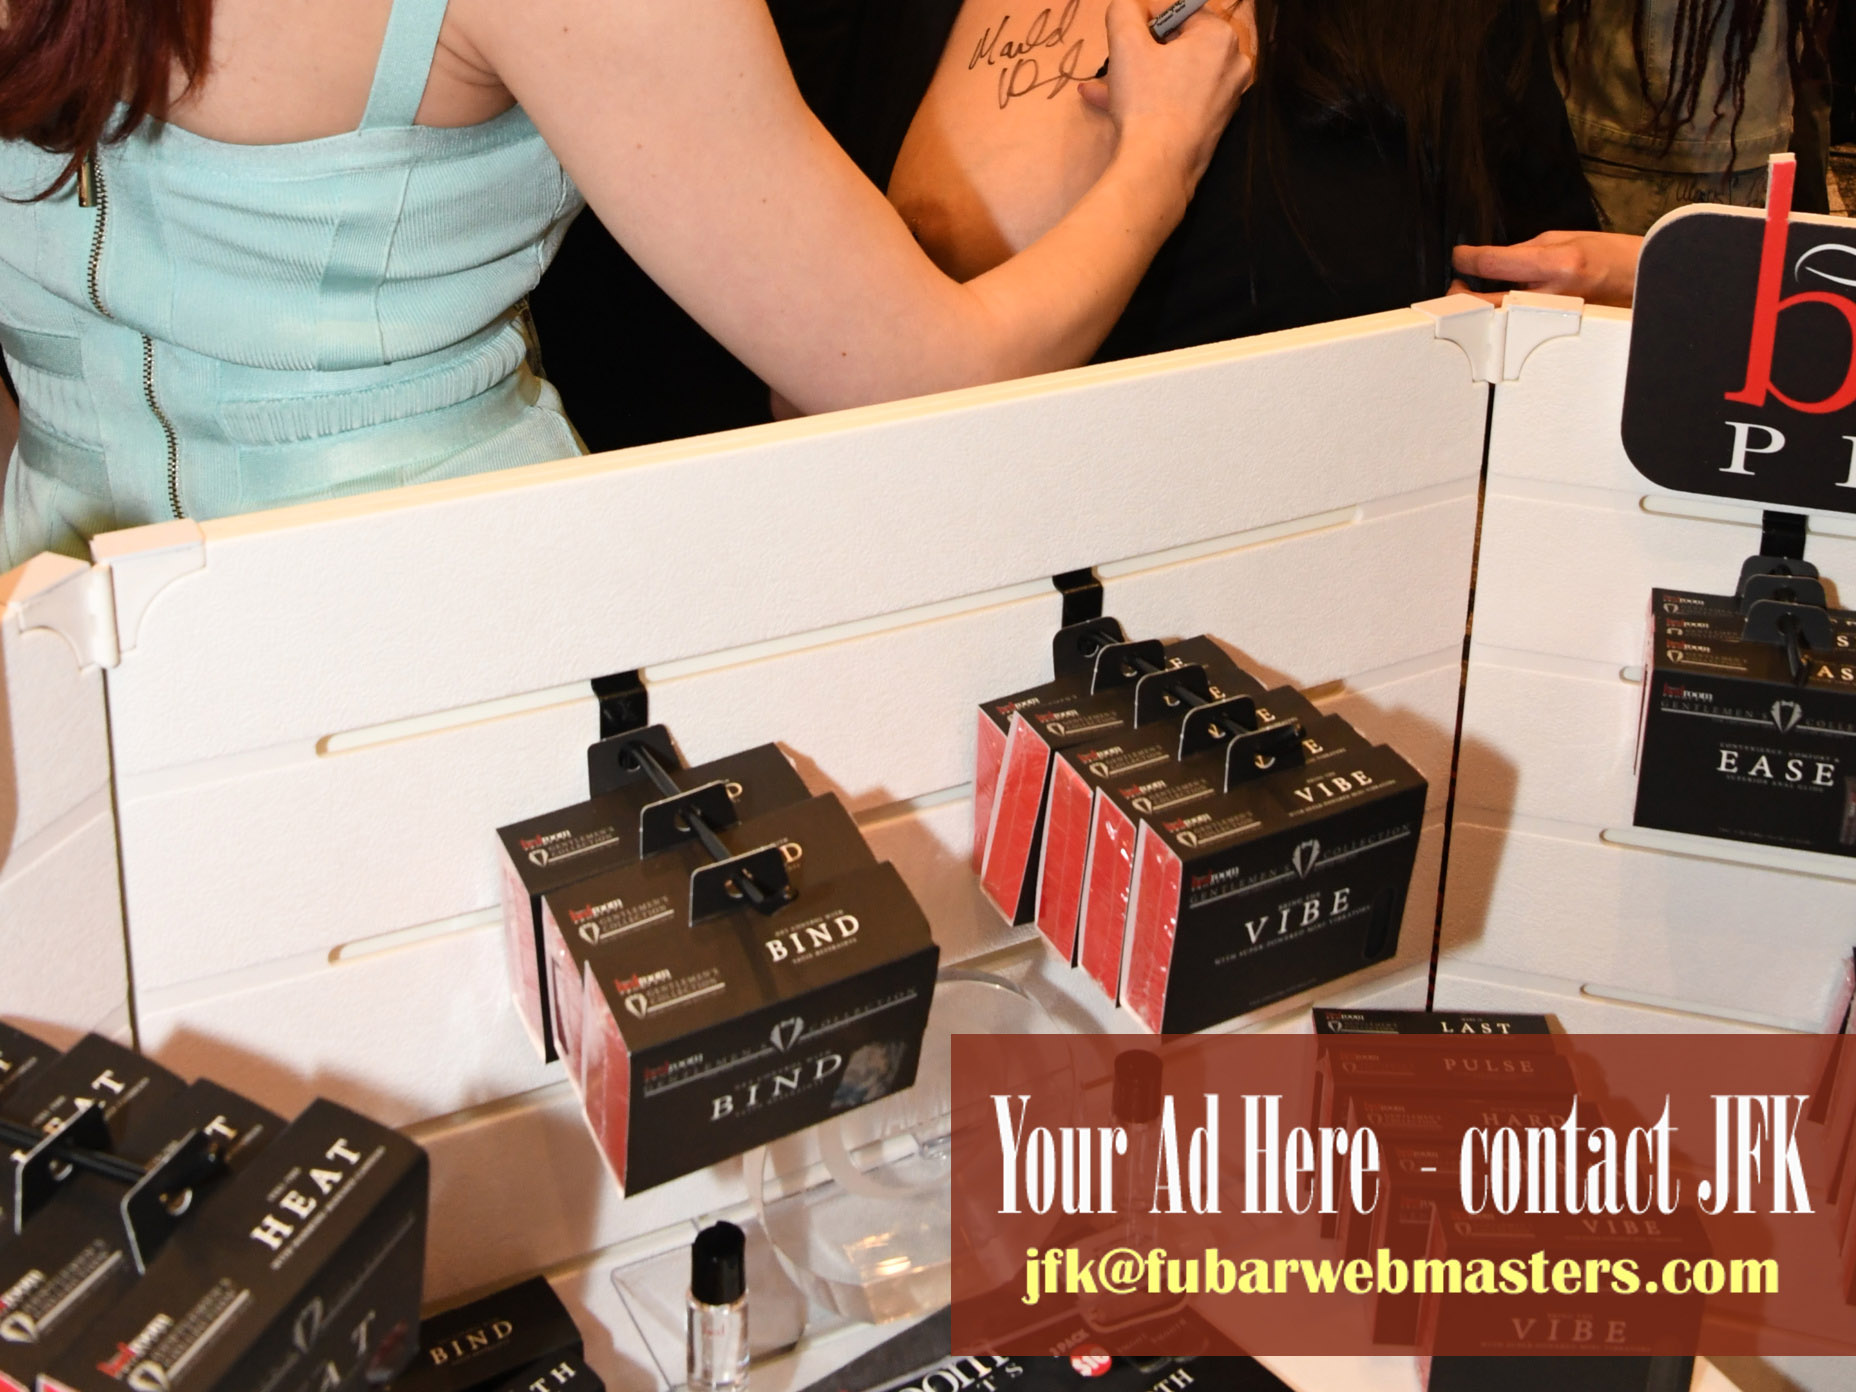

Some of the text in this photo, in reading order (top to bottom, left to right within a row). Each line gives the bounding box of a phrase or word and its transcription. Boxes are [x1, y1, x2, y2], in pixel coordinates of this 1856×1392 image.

[1294, 769, 1374, 805] VIBE
[1716, 749, 1836, 787] EASE
[1244, 887, 1352, 945] VIBE
[764, 914, 861, 963] BIND
[1440, 1020, 1512, 1035] LAST
[1443, 1057, 1535, 1074] PULSE
[710, 1054, 843, 1121] BIND
[250, 1136, 362, 1251] HEAT
[1582, 1219, 1662, 1237] VIBE
[429, 1320, 514, 1365] BIND
[1511, 1317, 1628, 1345] VIBE
